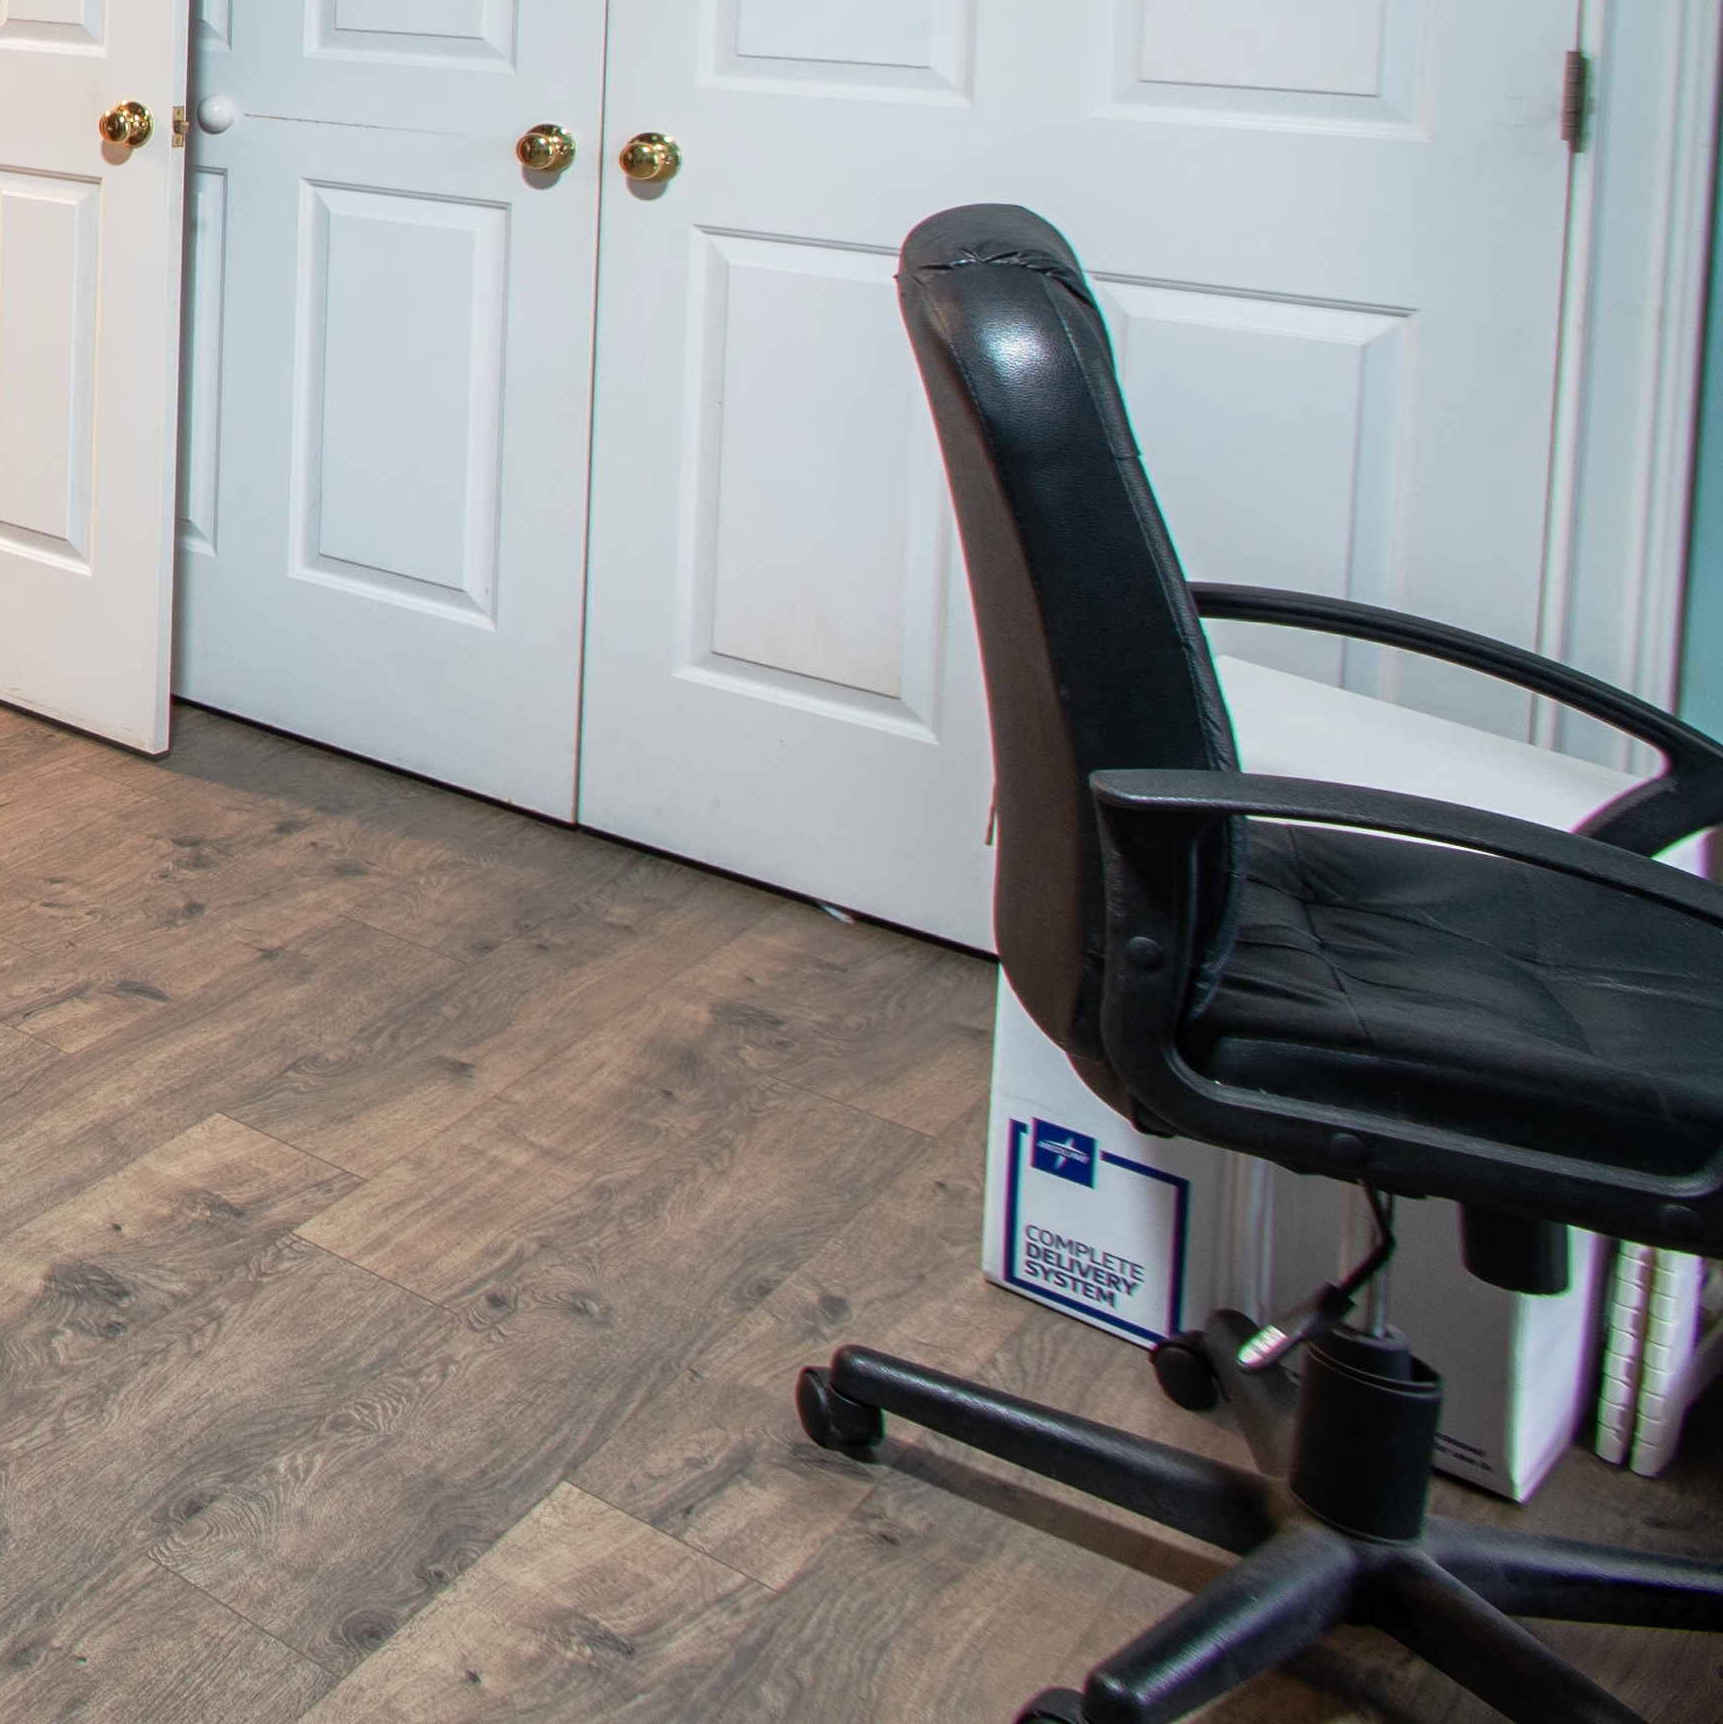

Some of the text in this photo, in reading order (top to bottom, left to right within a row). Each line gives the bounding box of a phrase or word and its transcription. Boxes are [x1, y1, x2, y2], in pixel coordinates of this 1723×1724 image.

[1025, 1242, 1137, 1297] DELIVERY
[1026, 1224, 1145, 1282] COMPLETE
[1025, 1262, 1116, 1308] SYSTEM
